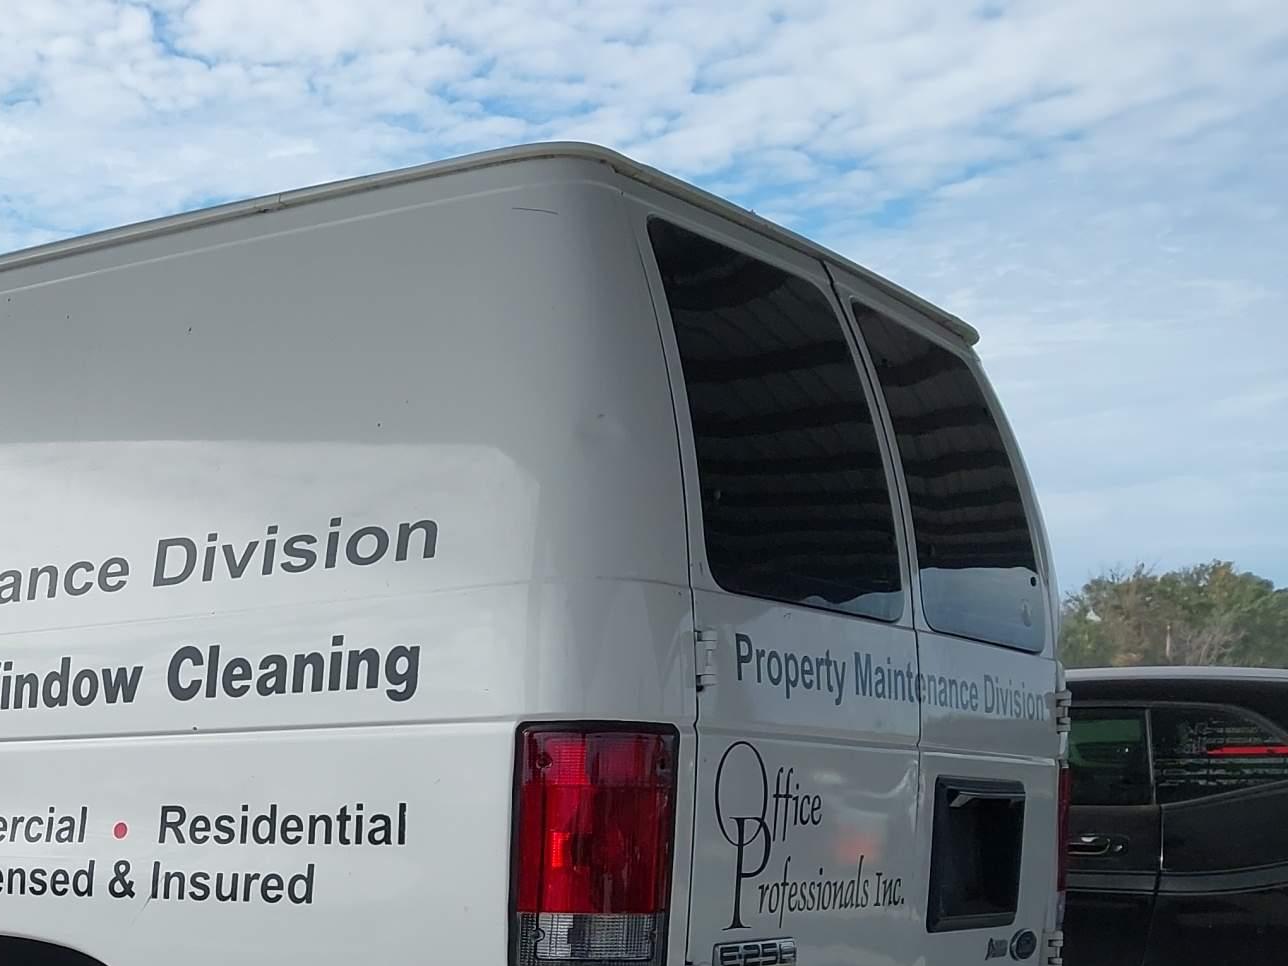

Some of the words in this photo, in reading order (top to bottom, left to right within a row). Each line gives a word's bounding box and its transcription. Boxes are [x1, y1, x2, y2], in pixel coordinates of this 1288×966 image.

[152, 516, 439, 588] Division
[166, 634, 421, 703] Cleaning
[734, 632, 847, 706] Property
[853, 650, 979, 712] Maintenance
[983, 673, 1046, 722] Division
[158, 802, 408, 846] Residential
[715, 741, 823, 848] Office
[107, 860, 136, 899] &
[150, 861, 316, 905] Insured
[722, 816, 870, 931] Professionals
[873, 872, 905, 907] Inc.
